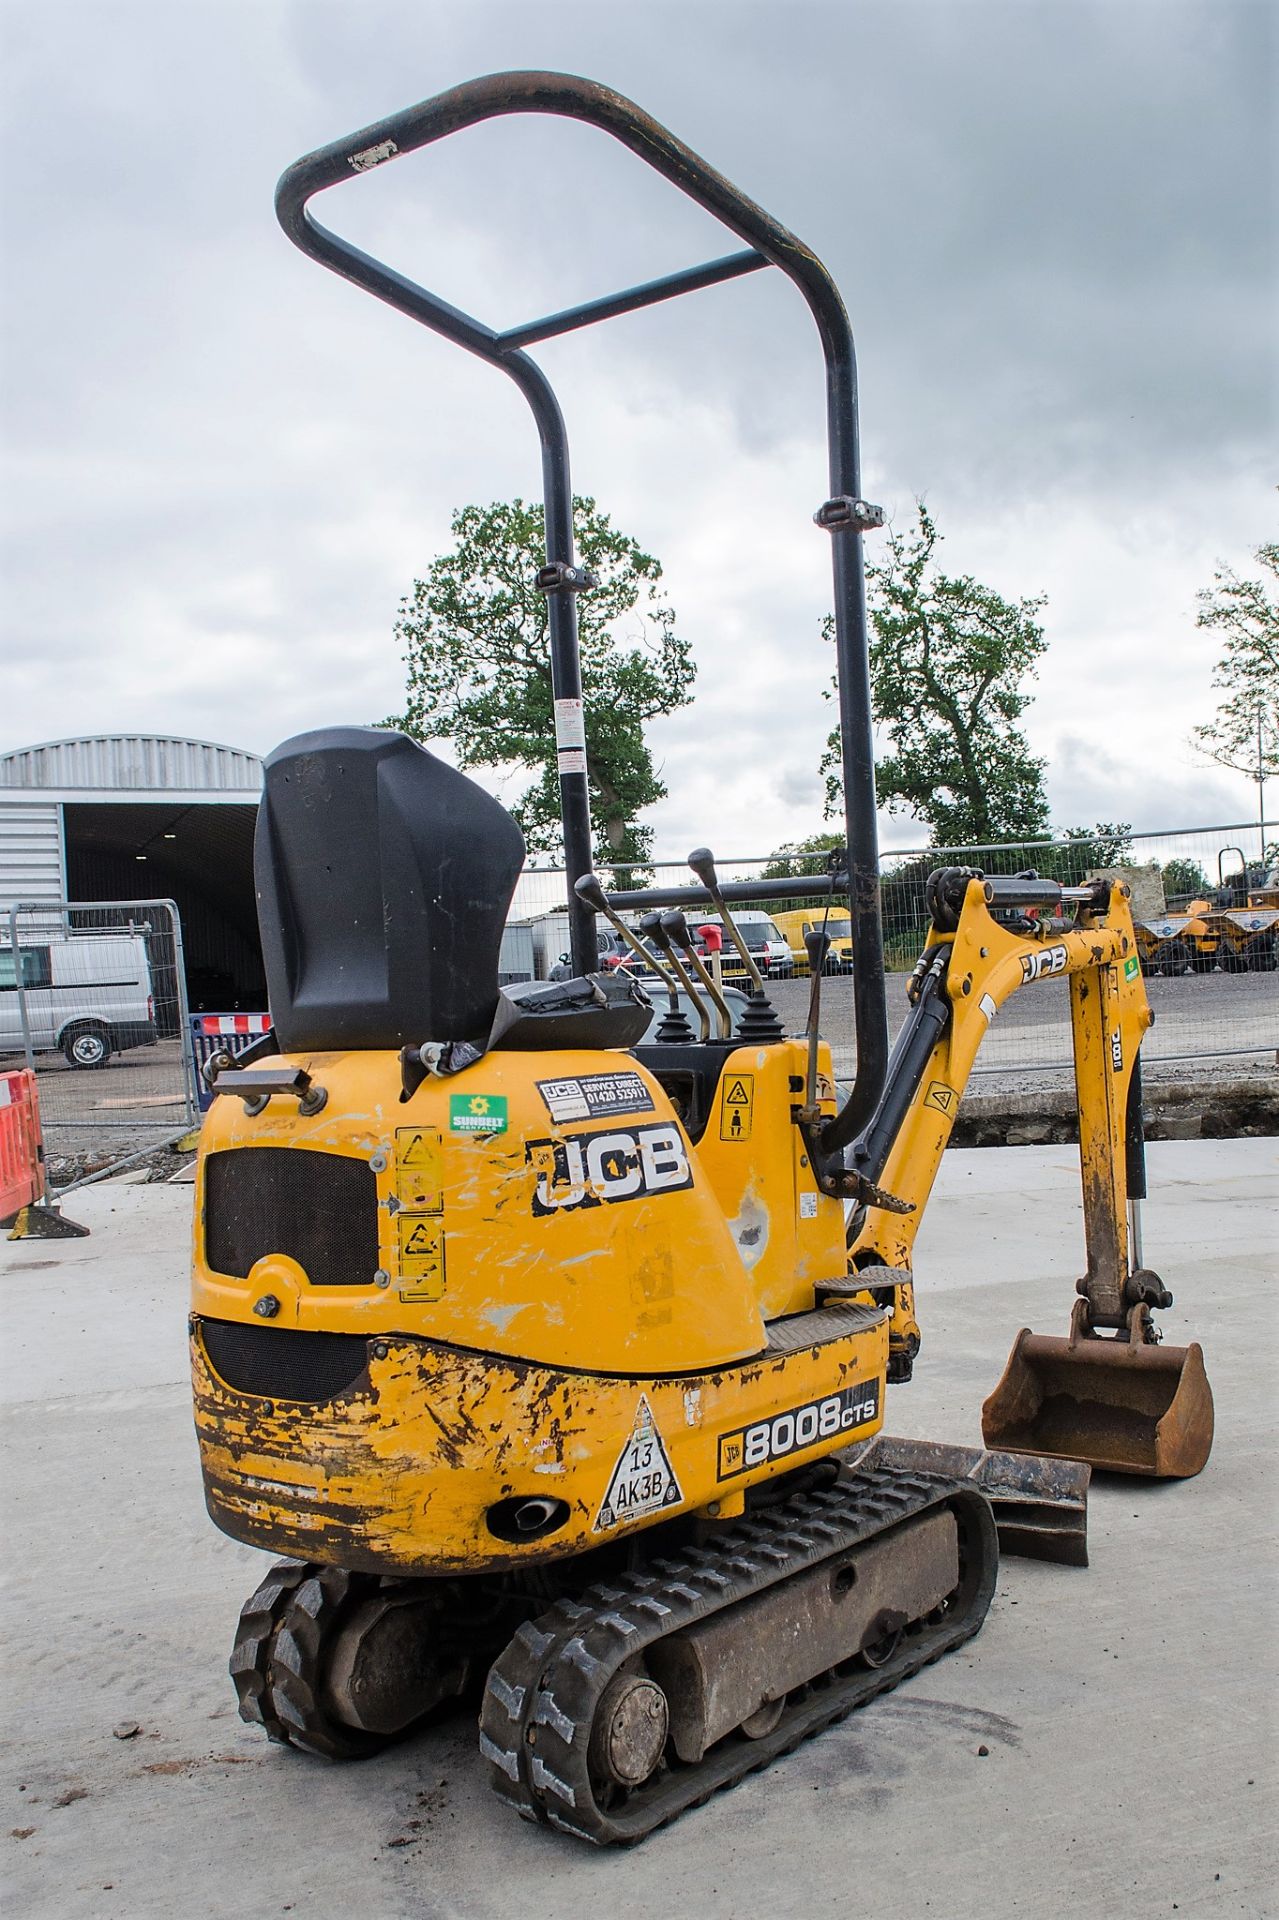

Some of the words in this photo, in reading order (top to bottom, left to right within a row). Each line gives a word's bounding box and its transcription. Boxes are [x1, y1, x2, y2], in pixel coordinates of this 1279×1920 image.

[1022, 946, 1067, 984] JCB
[548, 1084, 579, 1098] JCB
[582, 1081, 616, 1093] SERVICE
[615, 1079, 643, 1090] DIRECT
[587, 1091, 616, 1104] 01420
[617, 1087, 647, 1101] 525917
[453, 1116, 504, 1127] SUNBELT
[537, 1128, 689, 1207] JCB
[630, 1443, 654, 1473] 13
[616, 1471, 662, 1510] AK3B
